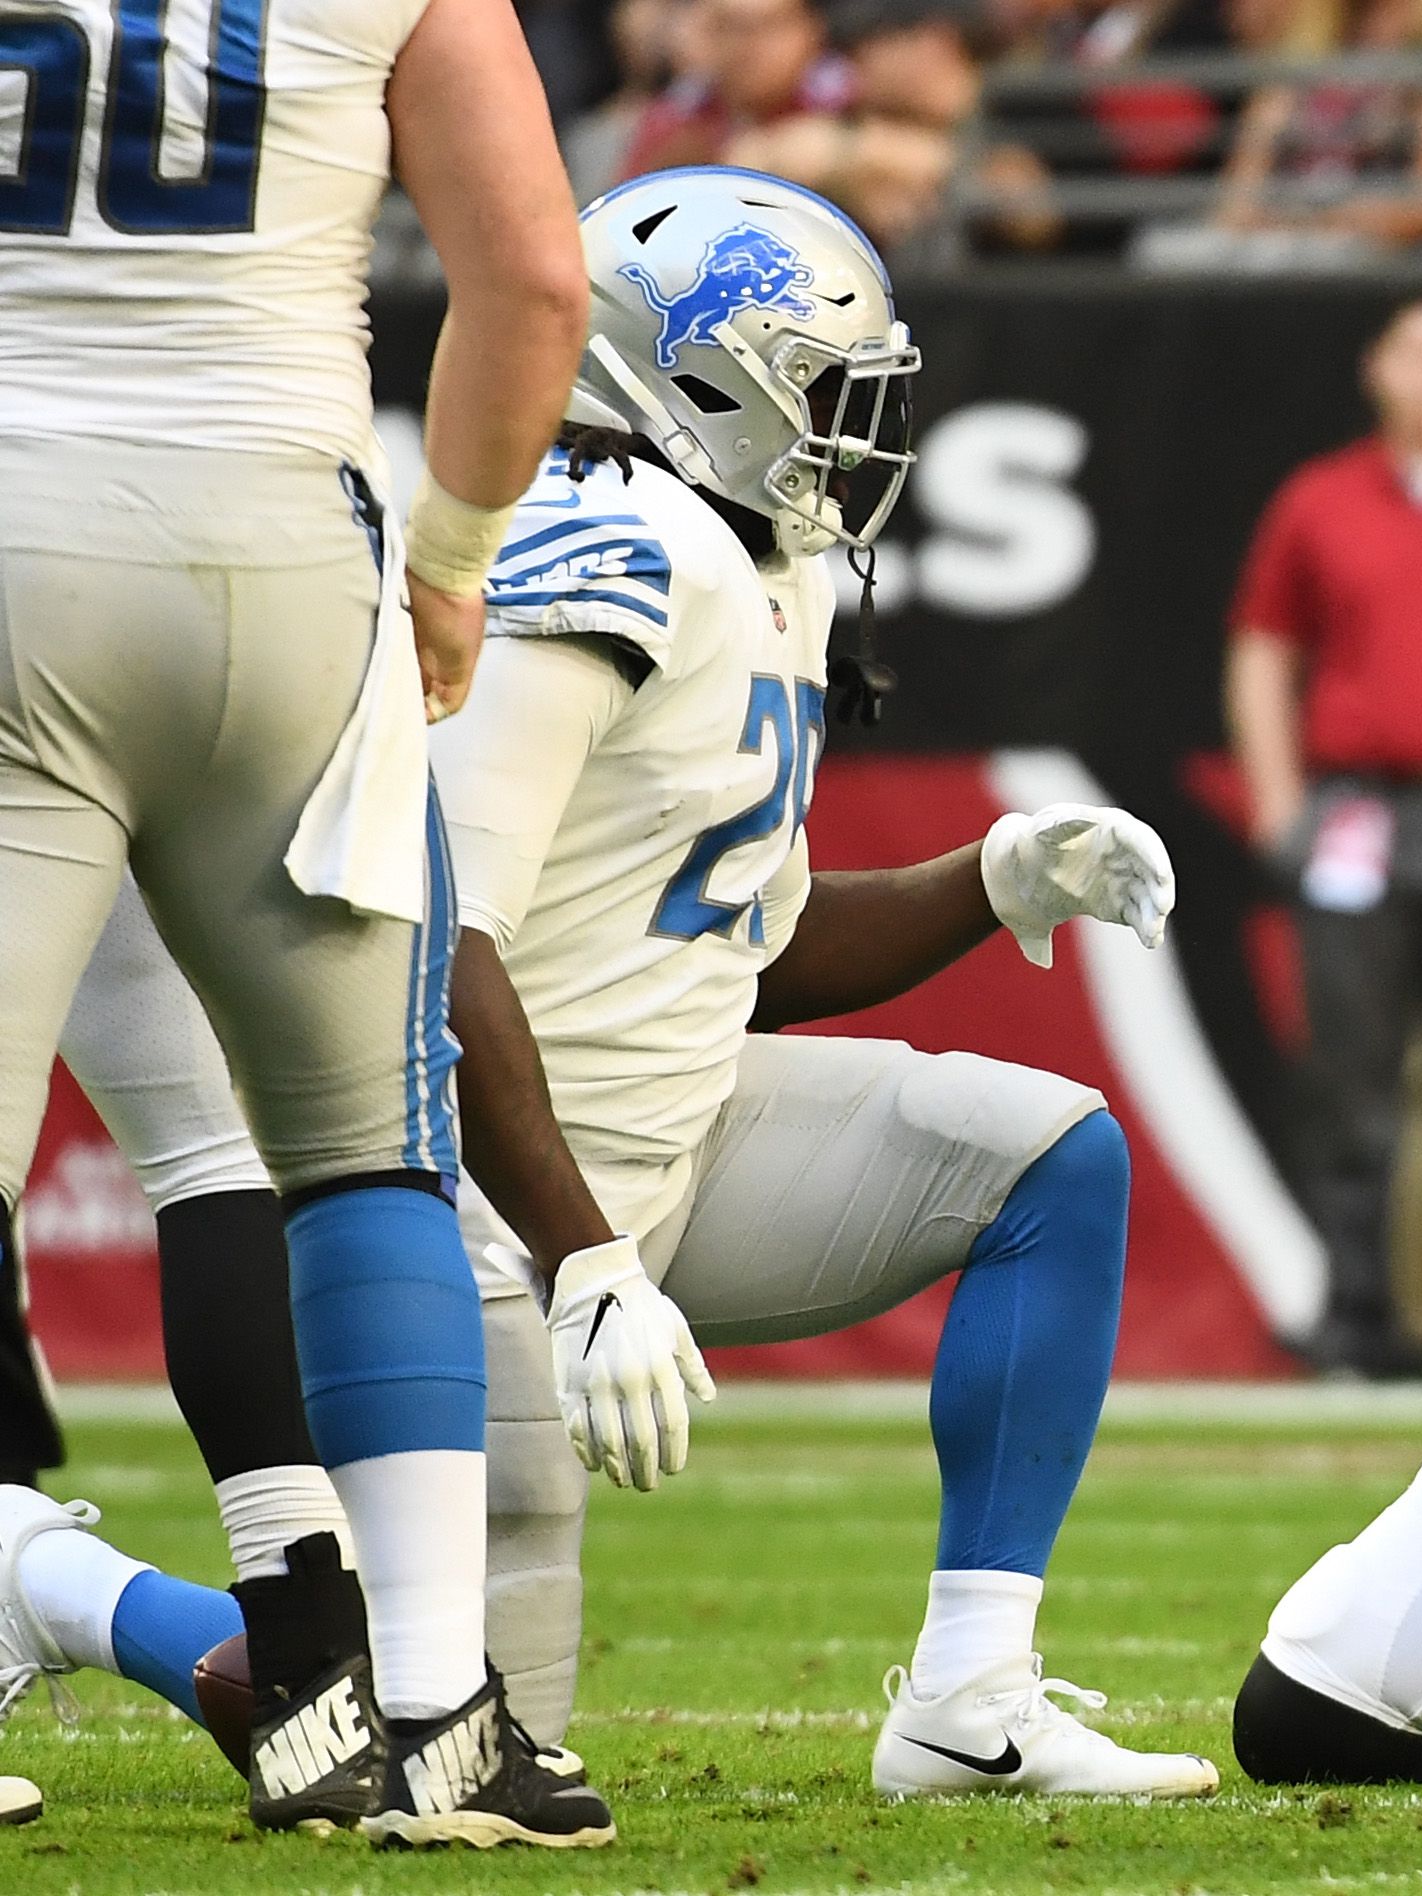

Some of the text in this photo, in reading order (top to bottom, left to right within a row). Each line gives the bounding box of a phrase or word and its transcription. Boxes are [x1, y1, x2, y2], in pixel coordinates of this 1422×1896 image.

[832, 400, 1098, 620] S
[255, 1675, 371, 1800] NIKE
[401, 1696, 503, 1818] NIKE
